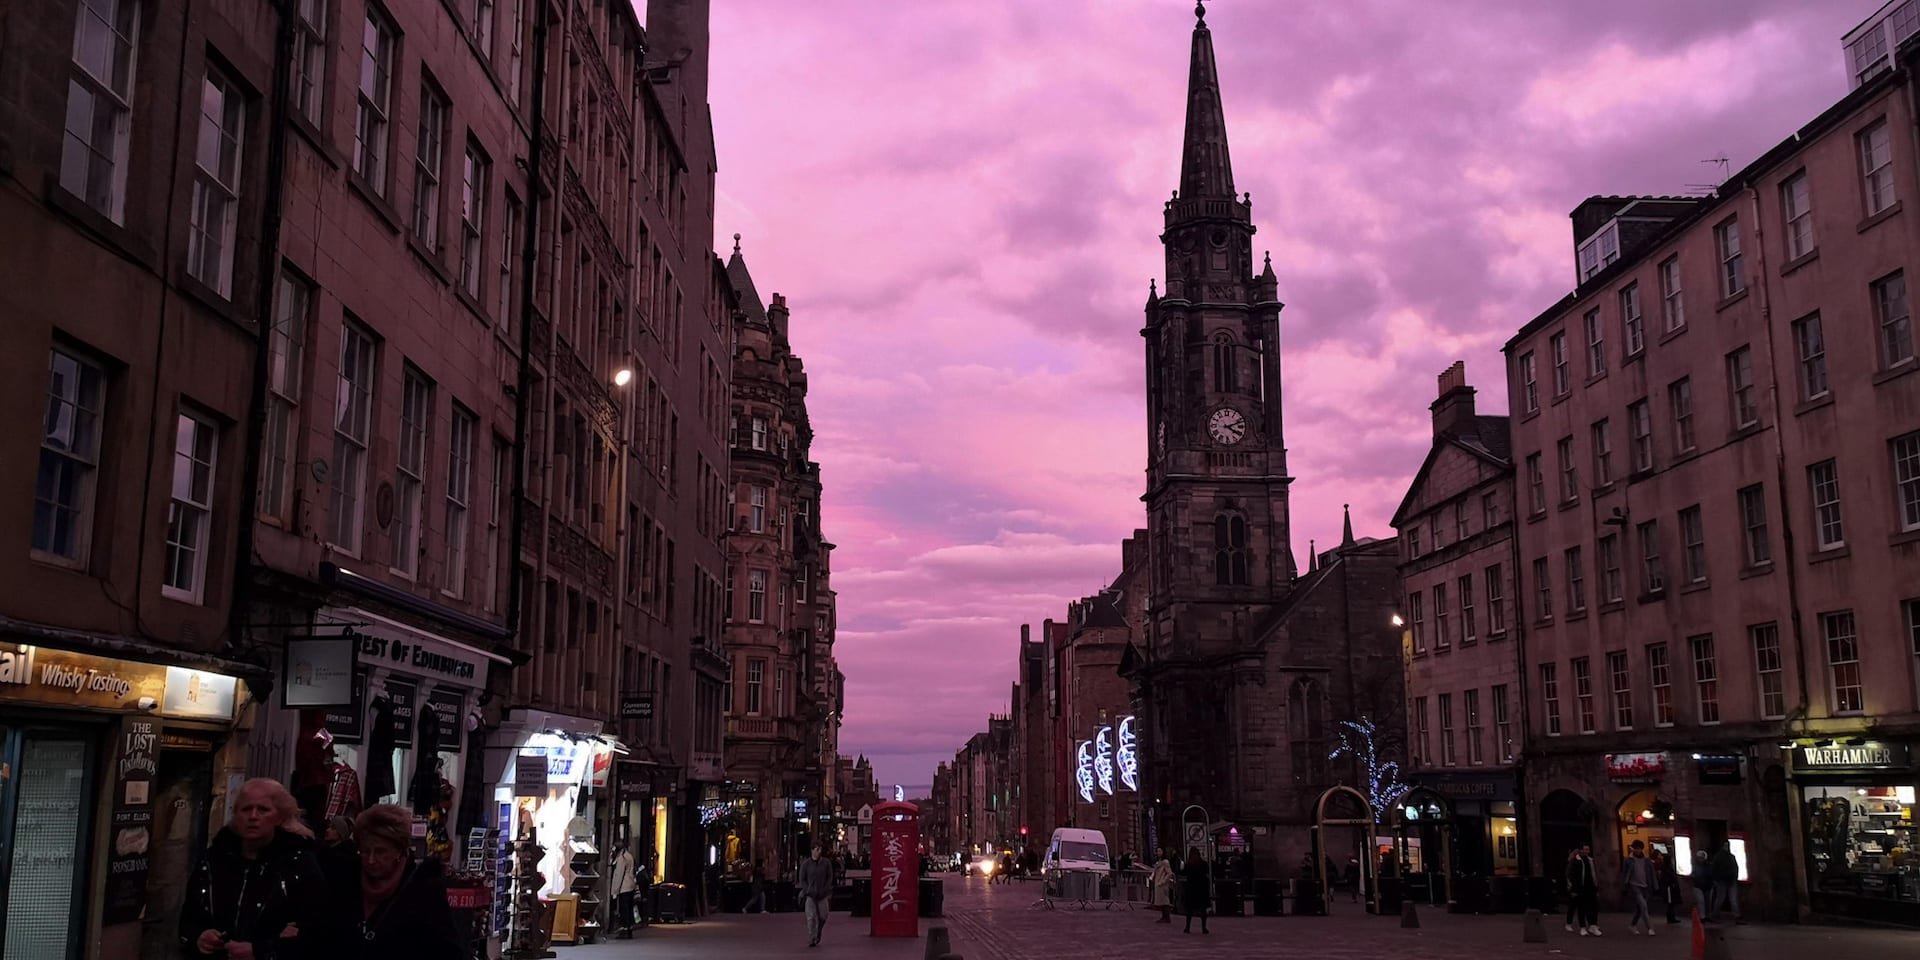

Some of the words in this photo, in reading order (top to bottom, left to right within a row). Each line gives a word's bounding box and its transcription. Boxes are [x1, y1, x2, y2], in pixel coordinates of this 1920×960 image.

[392, 640, 409, 662] OF
[413, 645, 474, 678] EDINBURGH
[41, 663, 88, 694] Whisky
[88, 669, 133, 699] Tastings
[132, 722, 152, 734] THE
[125, 733, 157, 755] LOST
[1804, 748, 1891, 765] WARHAMMER
